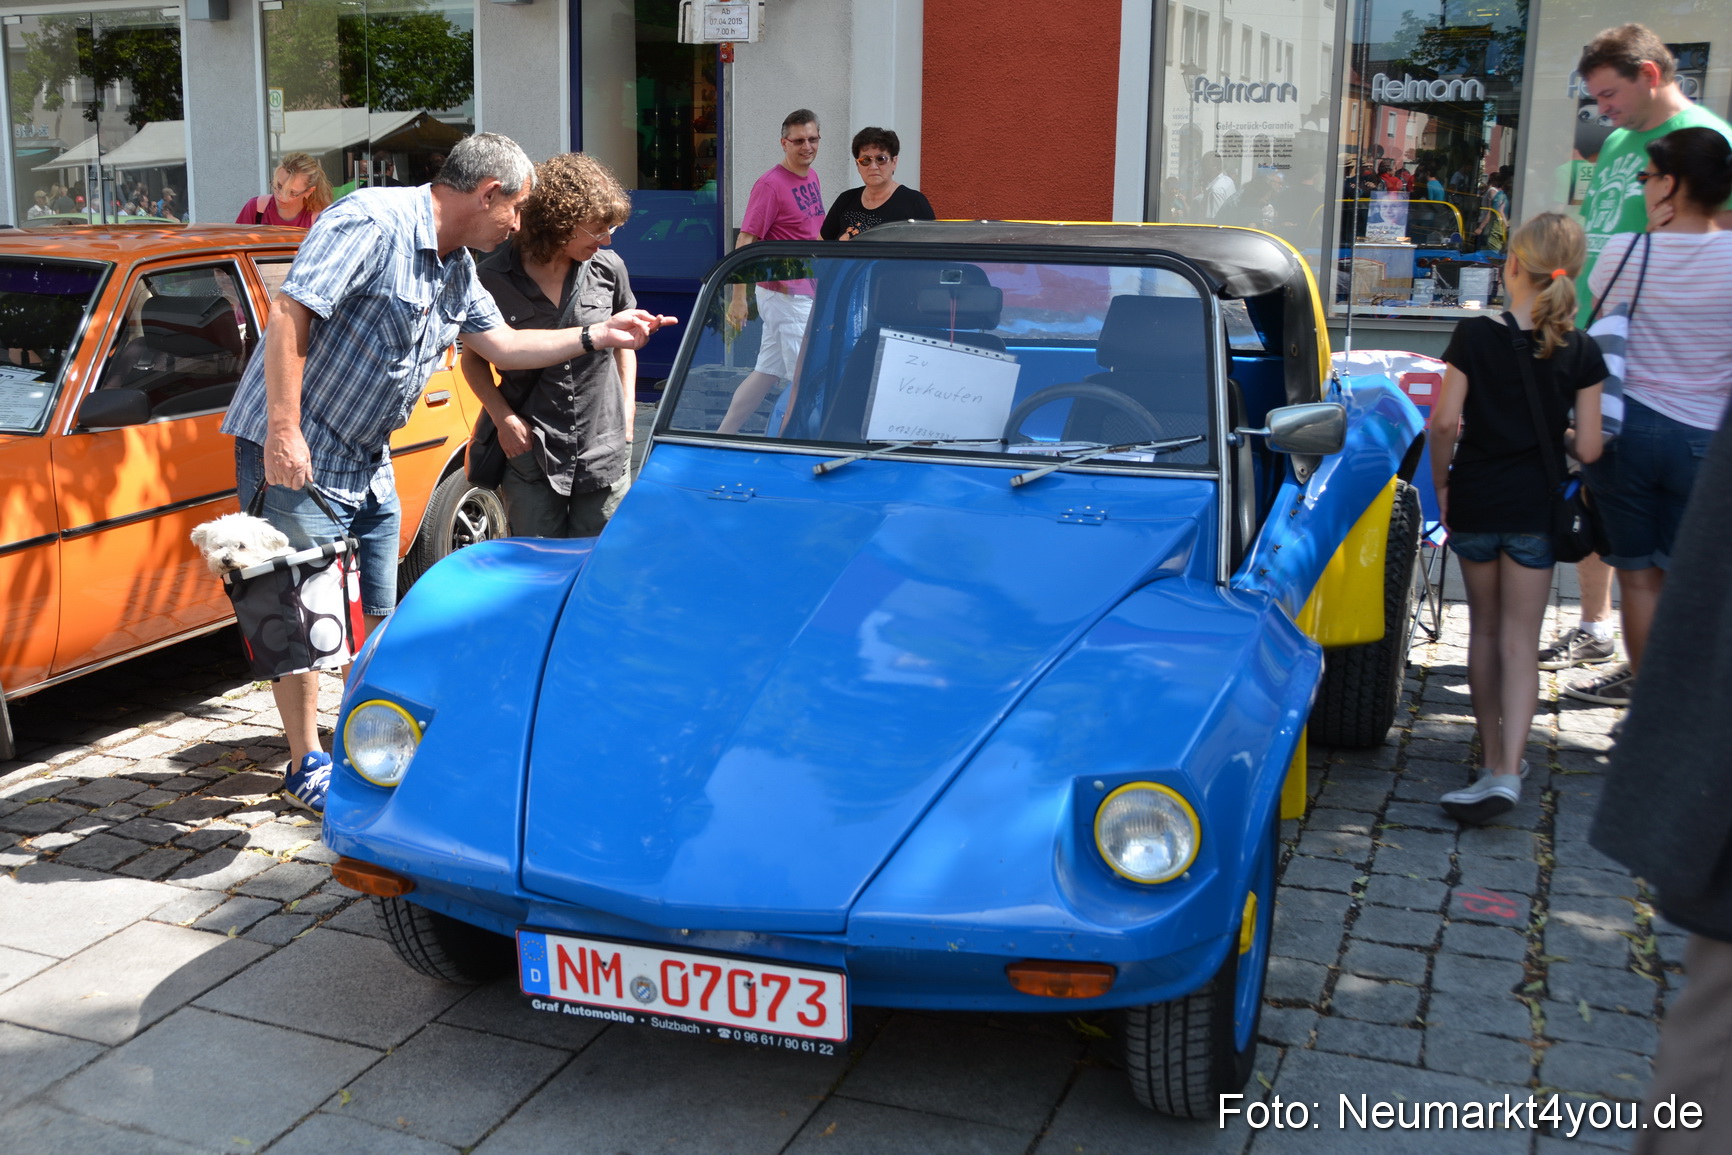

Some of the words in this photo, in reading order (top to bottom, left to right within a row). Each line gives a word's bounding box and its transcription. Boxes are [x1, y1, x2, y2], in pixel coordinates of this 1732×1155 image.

[1193, 75, 1298, 103] fielmann
[1371, 72, 1485, 101] fielmann
[1216, 121, 1294, 130] Geld-zurück-Garantie
[898, 377, 984, 404] Verkaufen
[530, 968, 542, 983] D
[556, 944, 624, 999] NM
[660, 959, 828, 1028] 07073
[531, 998, 559, 1013] Graf
[562, 1003, 635, 1024] Automobile
[650, 1016, 701, 1034] Sulzbach
